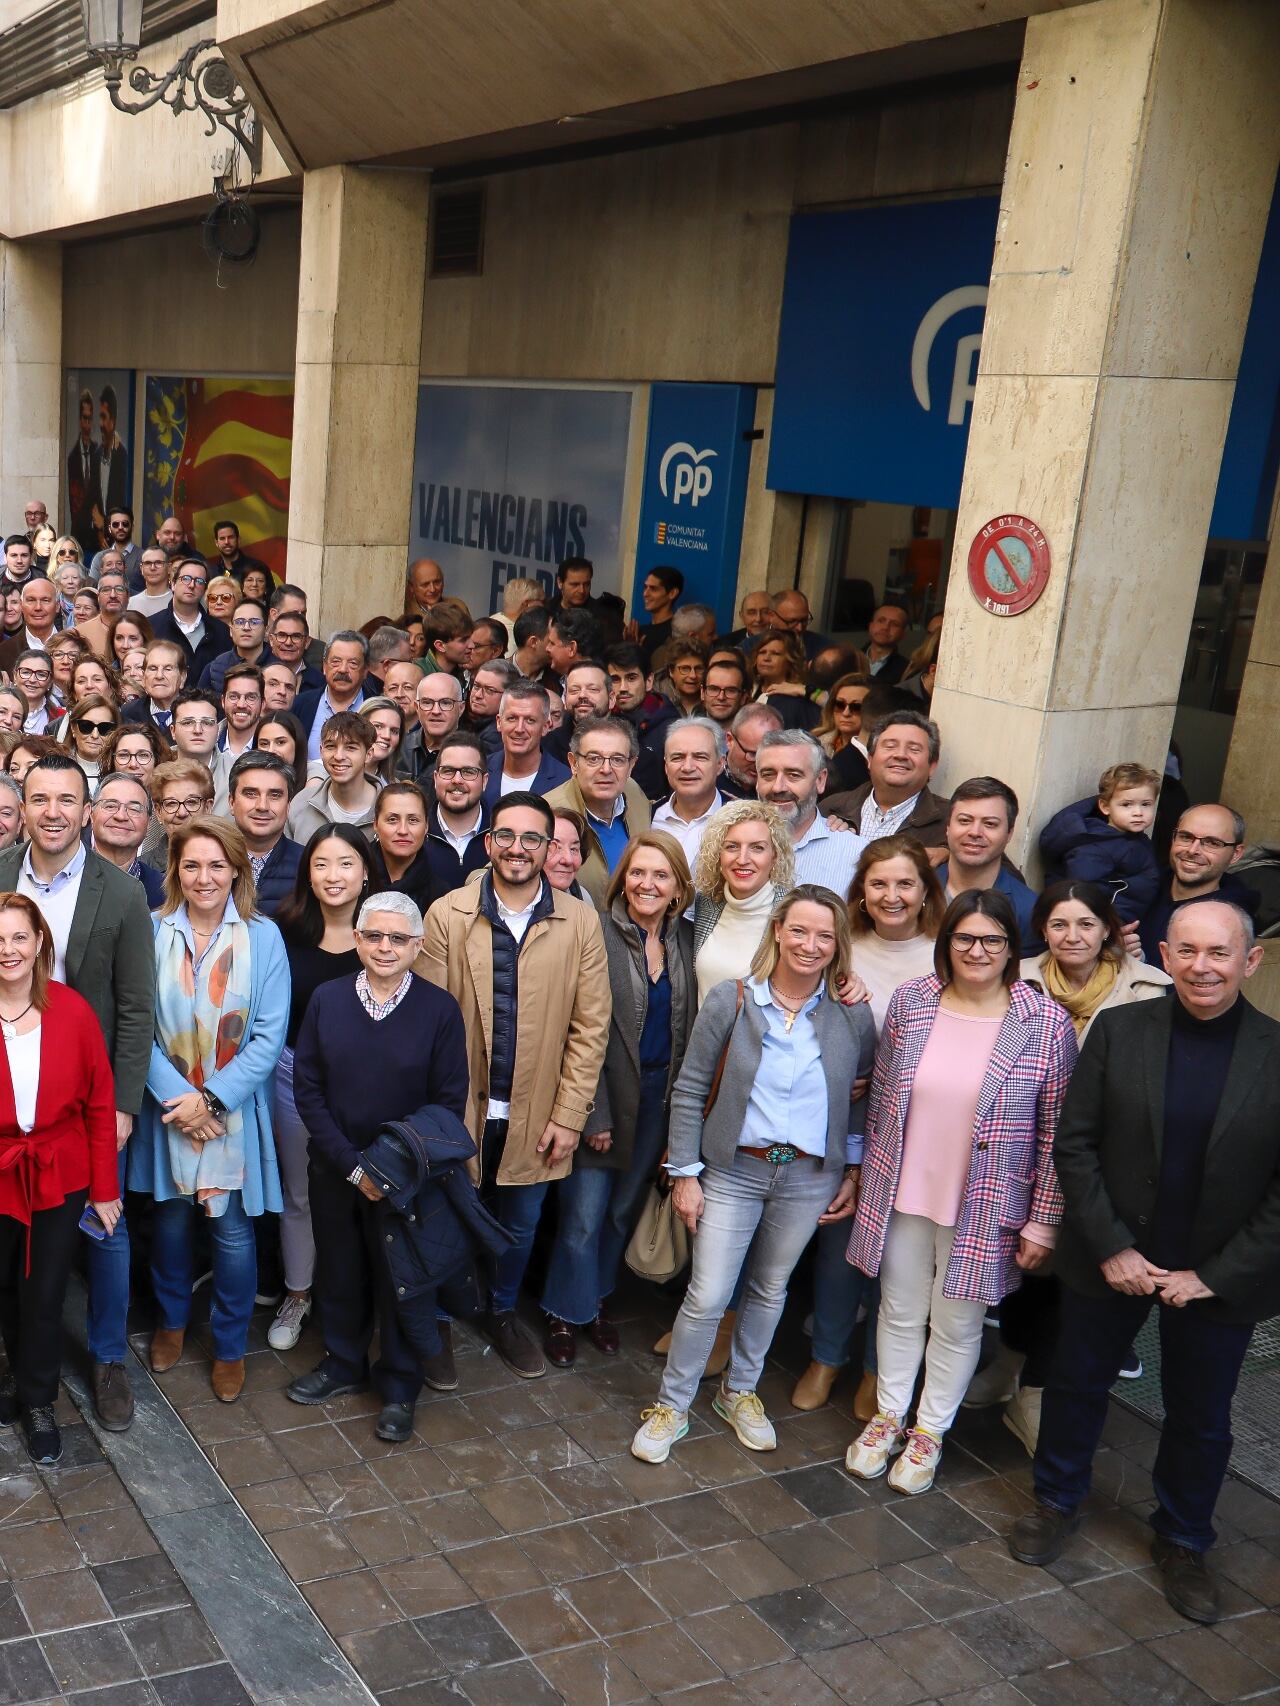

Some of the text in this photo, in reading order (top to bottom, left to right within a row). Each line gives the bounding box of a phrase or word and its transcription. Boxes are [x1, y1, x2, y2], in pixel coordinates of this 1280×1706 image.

[419, 482, 587, 564] VALENCIANS
[667, 523, 706, 538] COMUNITAT
[982, 524, 995, 538] DE
[666, 536, 709, 552] VALENCIANA
